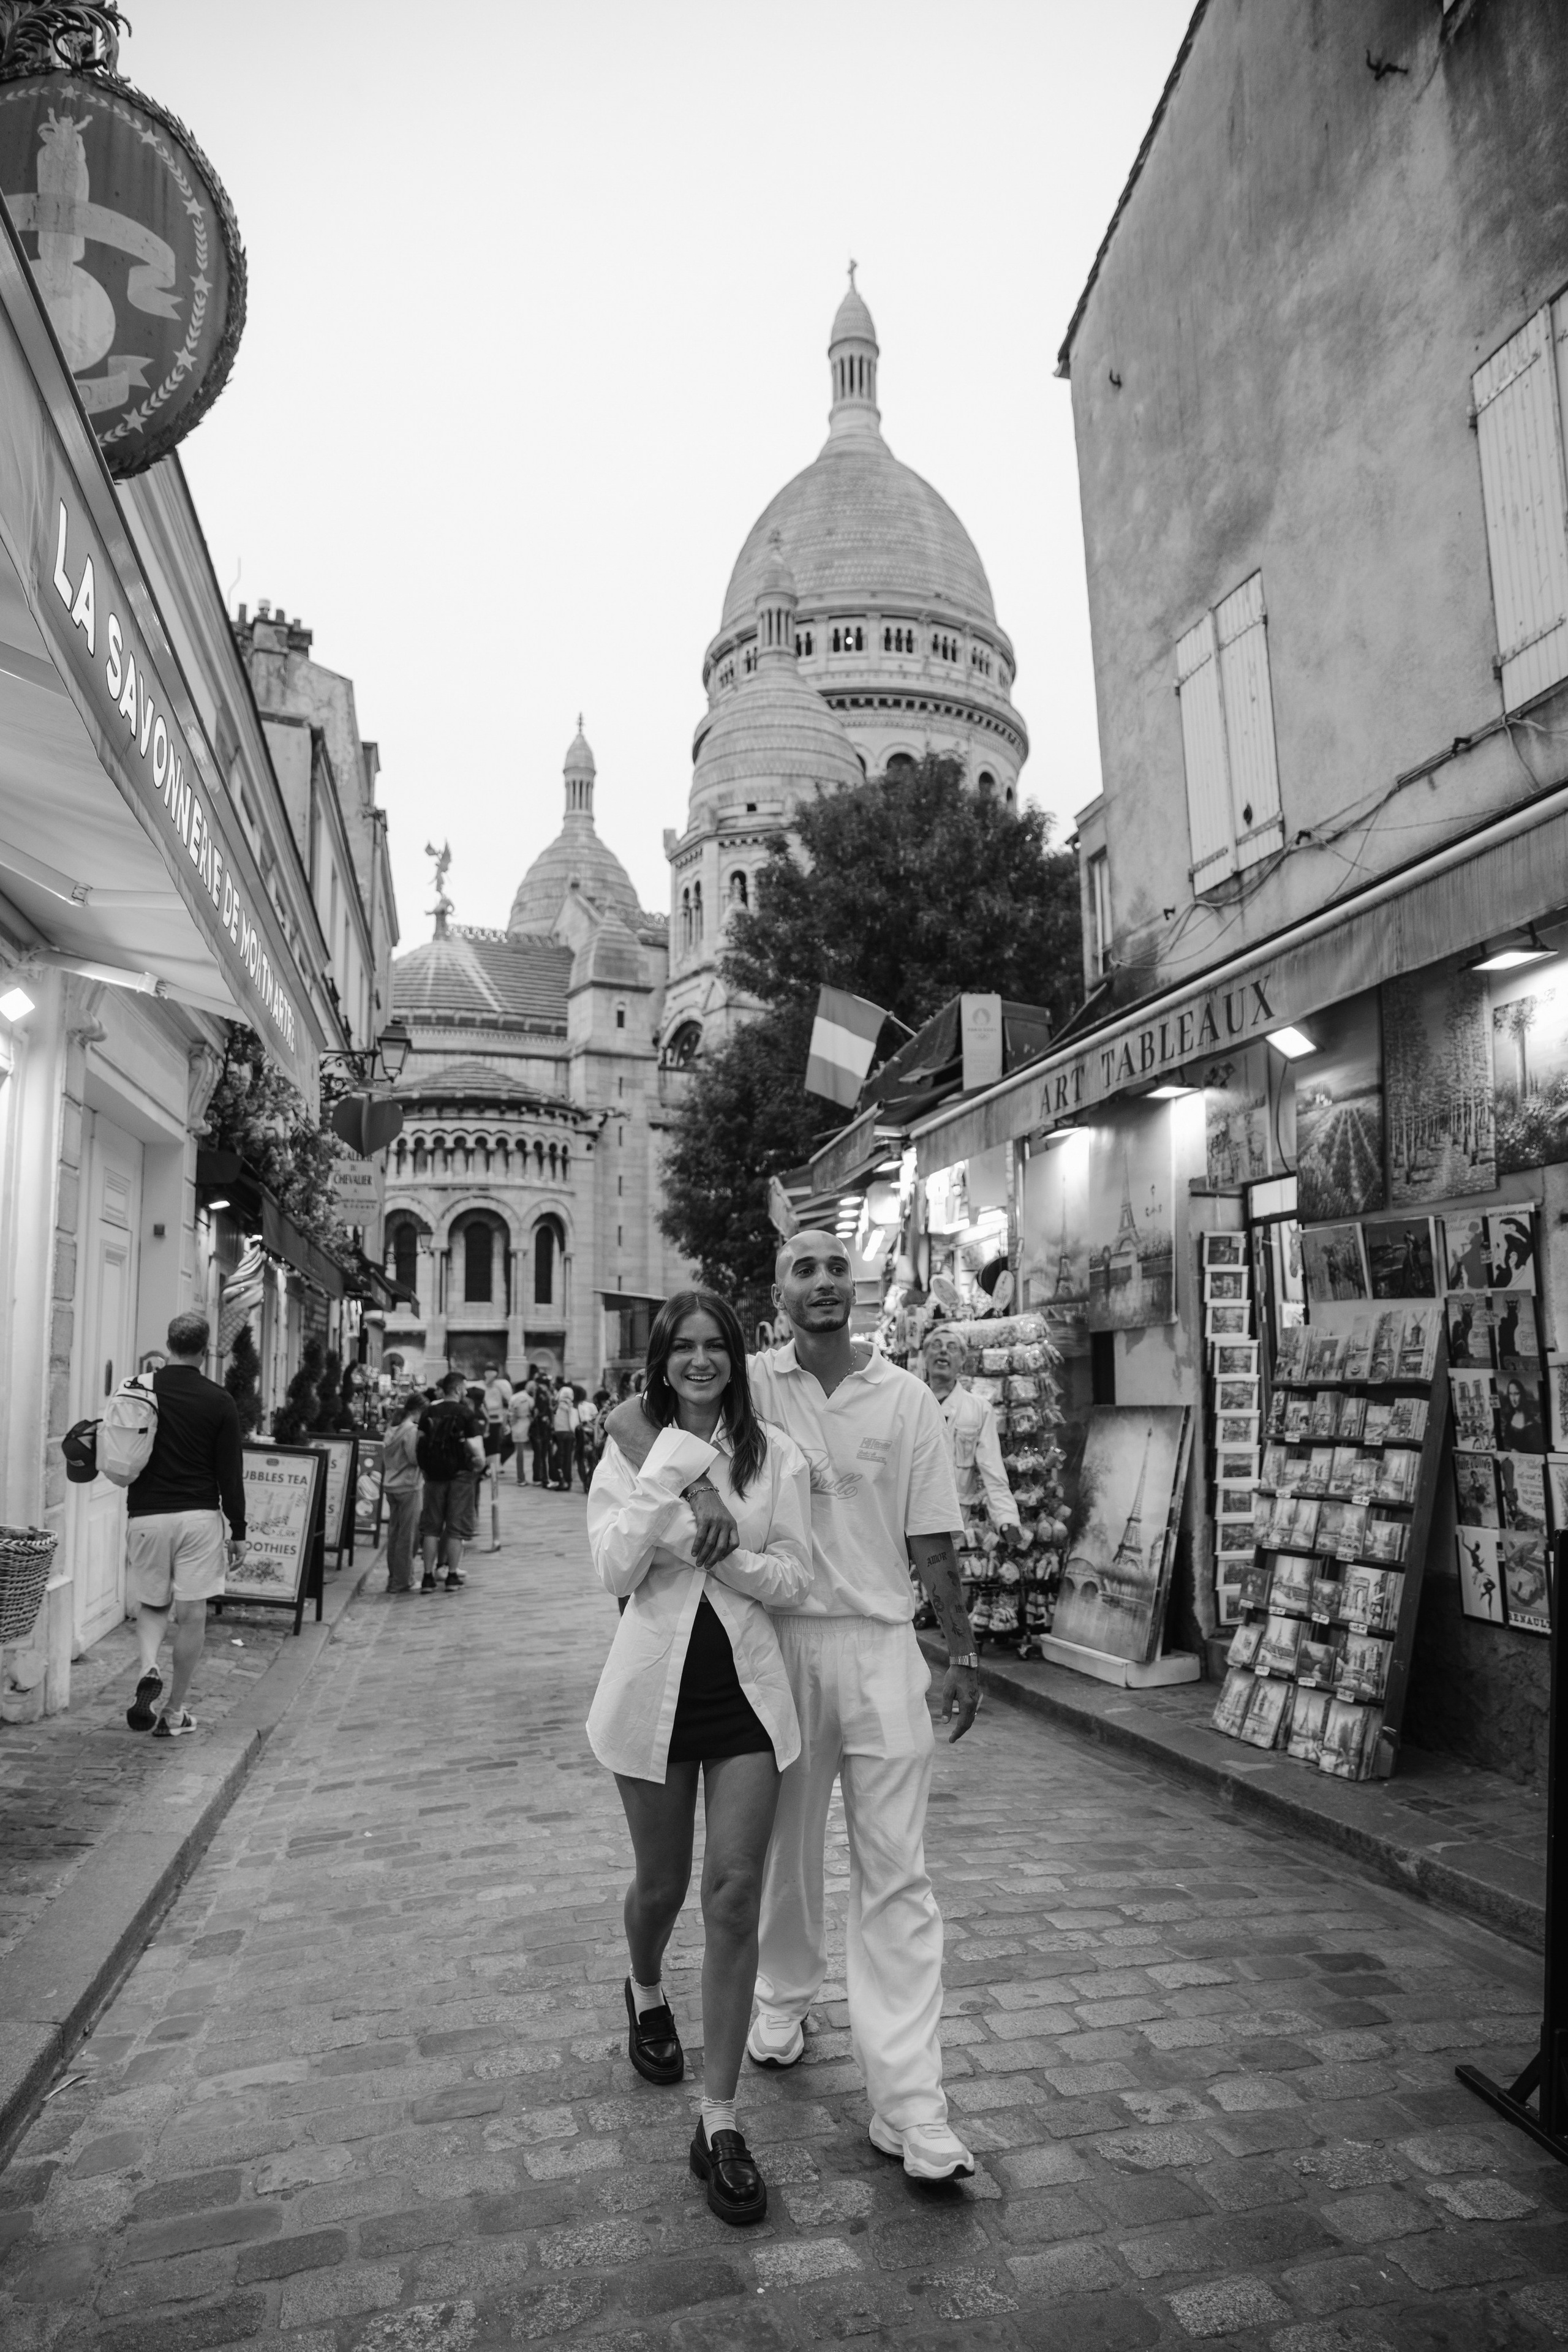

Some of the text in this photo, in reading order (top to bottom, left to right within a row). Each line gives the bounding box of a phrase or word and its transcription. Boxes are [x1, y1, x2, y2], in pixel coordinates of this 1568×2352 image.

[53, 497, 96, 657] LA
[105, 612, 224, 910] SAVONNERIE
[222, 872, 239, 946] DE
[1039, 974, 1275, 1119] ART TABLEAUX
[333, 1173, 372, 1185] CHEVALIER
[243, 1471, 308, 1485] UBBLES TEA
[224, 1539, 296, 1555] SOOTHIES
[927, 1551, 948, 1567] AMOR
